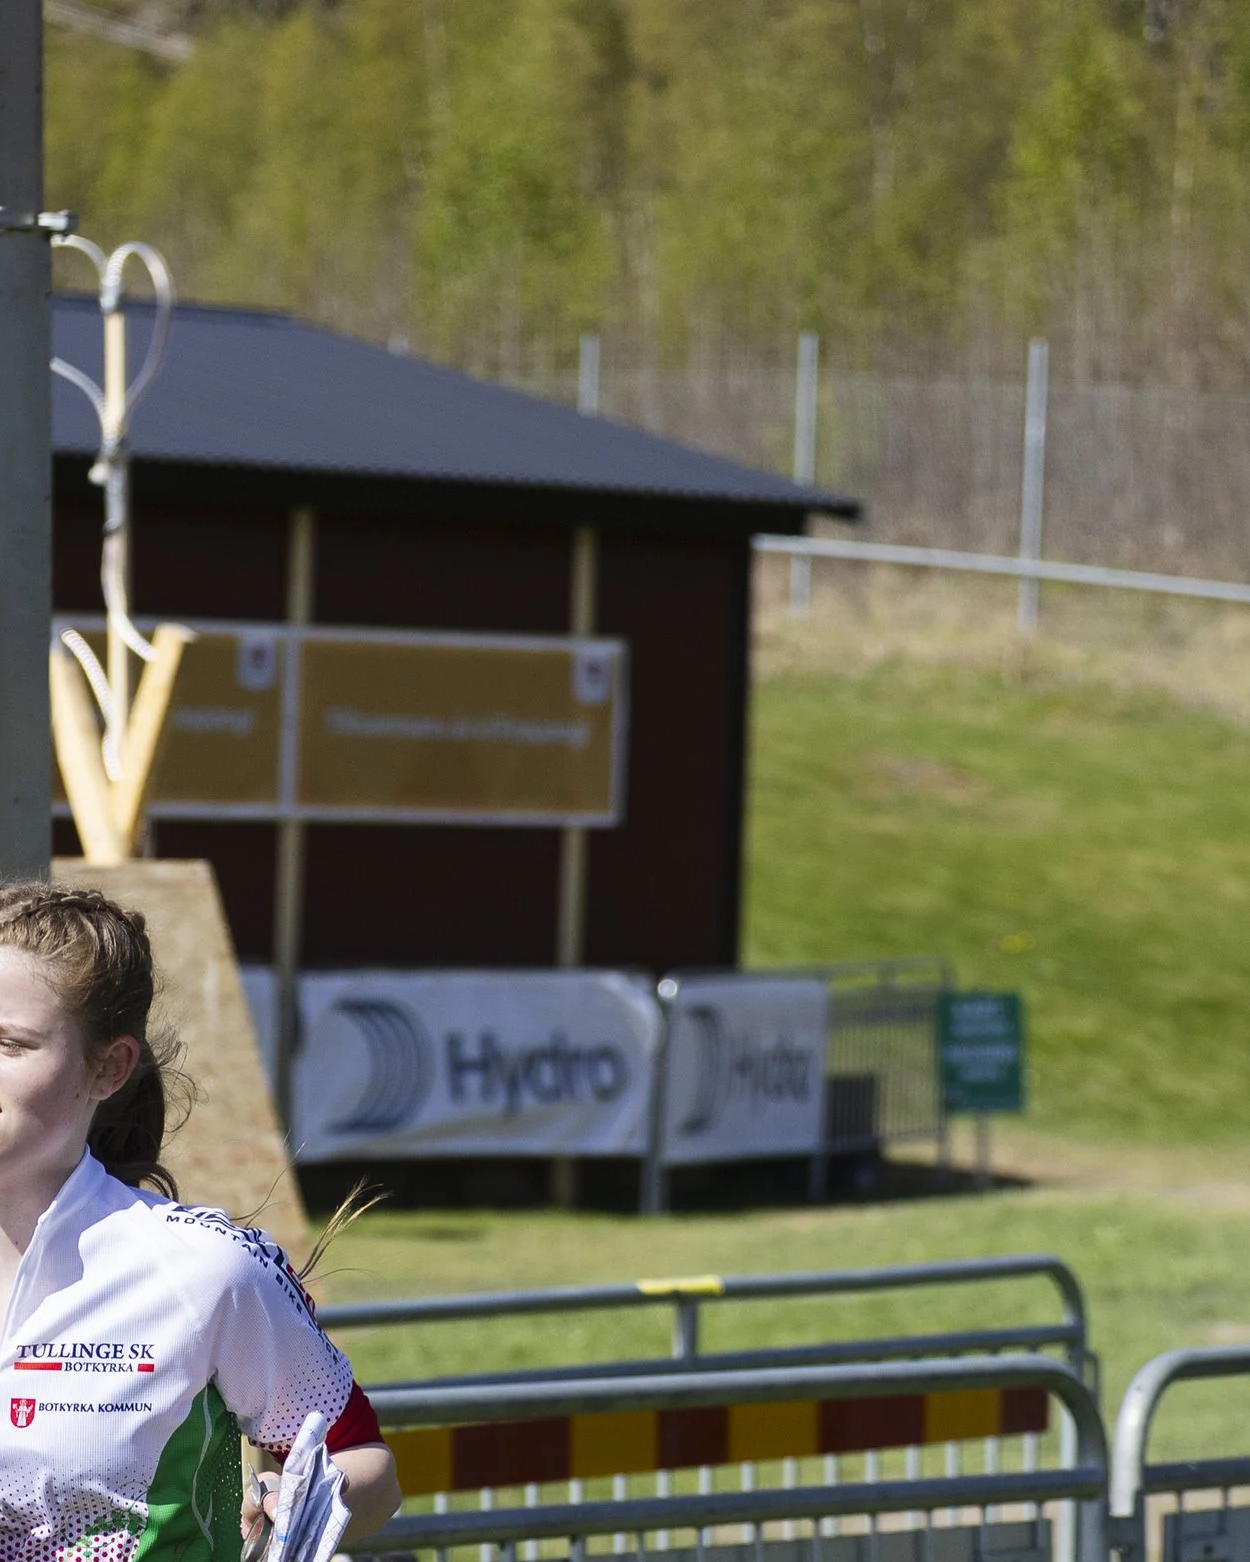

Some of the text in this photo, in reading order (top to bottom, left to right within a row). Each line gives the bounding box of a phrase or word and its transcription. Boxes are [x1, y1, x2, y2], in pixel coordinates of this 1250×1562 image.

[445, 1028, 629, 1121] Hydro
[166, 1214, 269, 1268] MOUNTAIN
[275, 1273, 302, 1314] BIKE
[16, 1343, 155, 1359] TULLINGE SK
[63, 1362, 133, 1373] BOTKYRKA
[38, 1403, 152, 1413] BOTKYRKA KOMMUN
